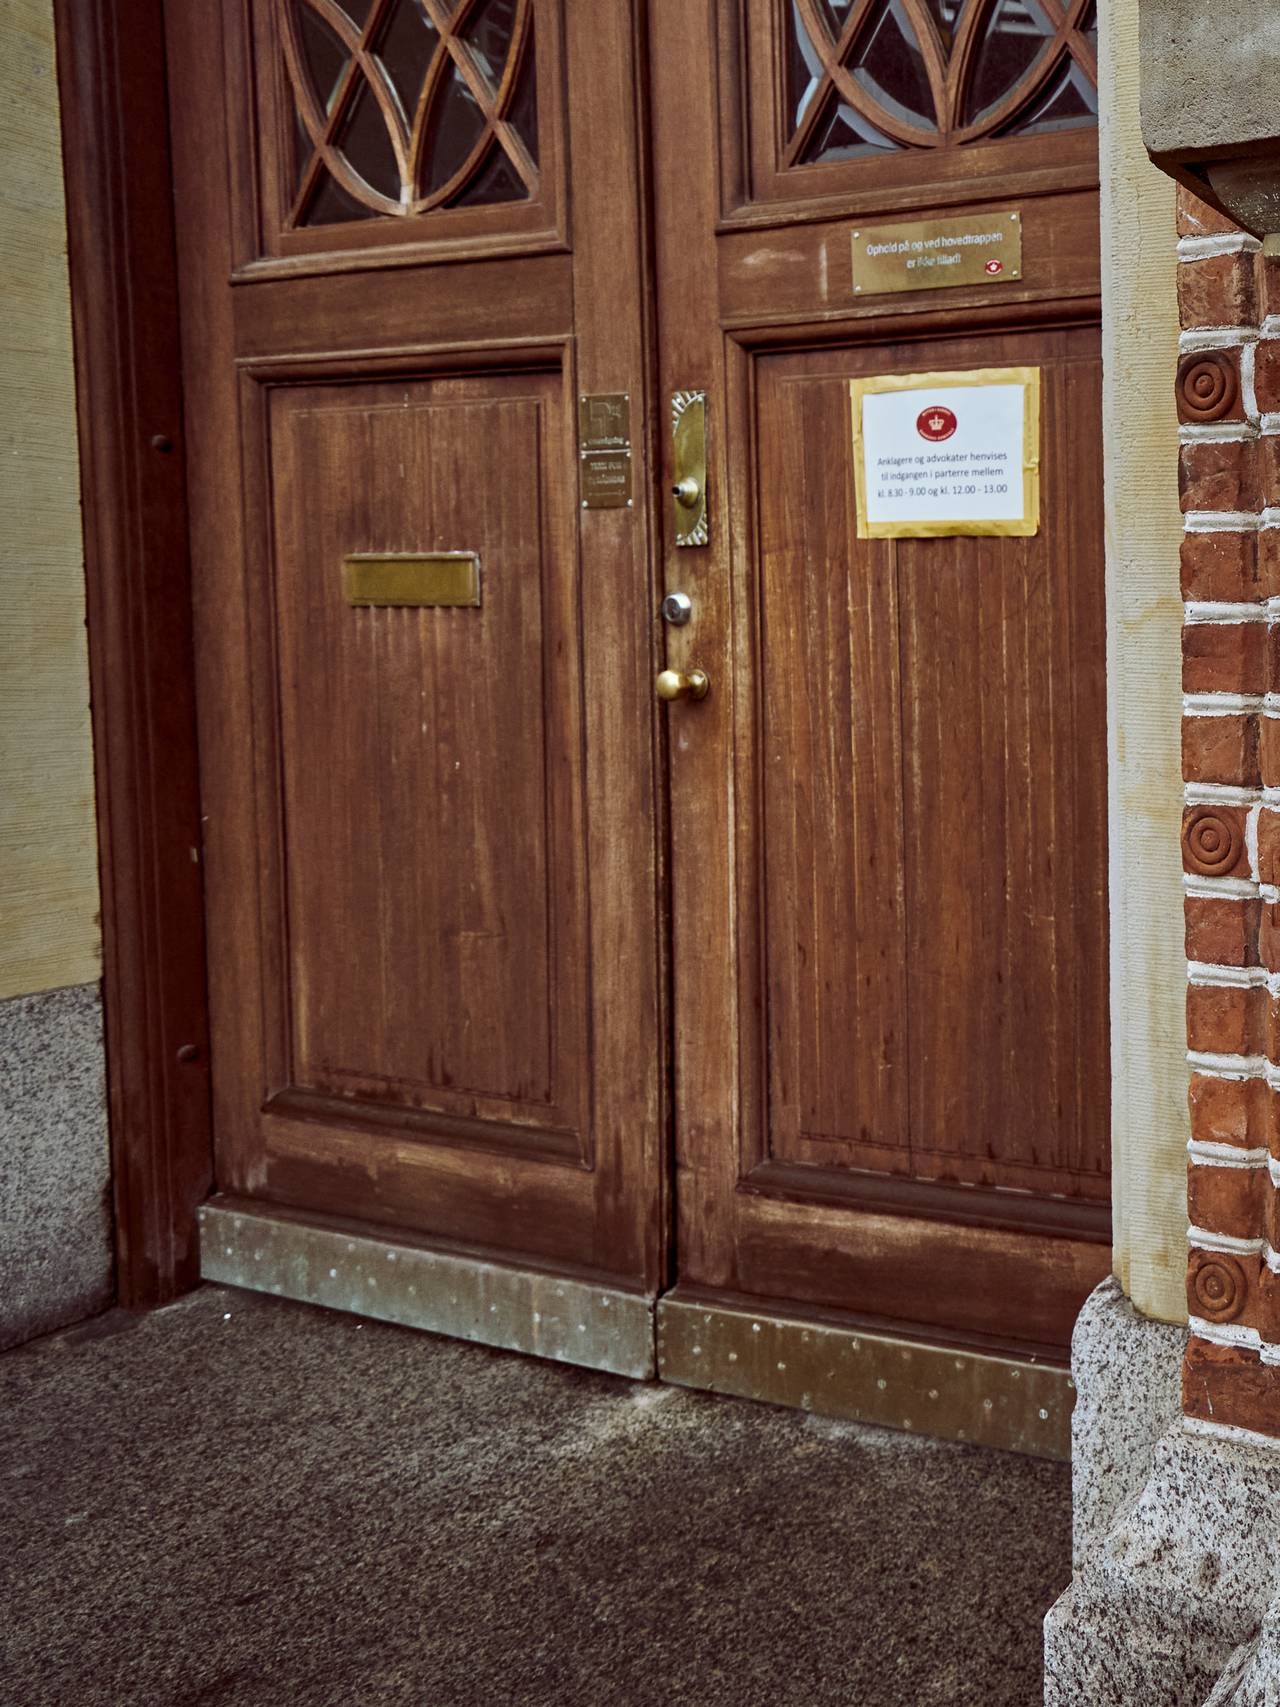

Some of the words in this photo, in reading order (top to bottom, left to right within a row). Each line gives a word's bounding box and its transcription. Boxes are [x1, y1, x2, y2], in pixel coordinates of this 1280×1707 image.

[911, 240, 923, 252] og
[924, 237, 940, 249] ved
[941, 232, 1003, 247] hovedtrappen
[877, 456, 913, 467] Anklagere
[914, 455, 925, 465] og
[926, 453, 968, 463] advokater
[970, 451, 1008, 461] henvises
[881, 472, 889, 481] til
[890, 470, 928, 481] indgangen
[934, 468, 970, 479] parterre
[971, 466, 1004, 477] mellem
[909, 486, 927, 496] 9.00
[928, 487, 938, 497] og
[939, 485, 949, 495] kl.
[952, 484, 976, 495] 12.00
[984, 483, 1008, 494] 13.00
